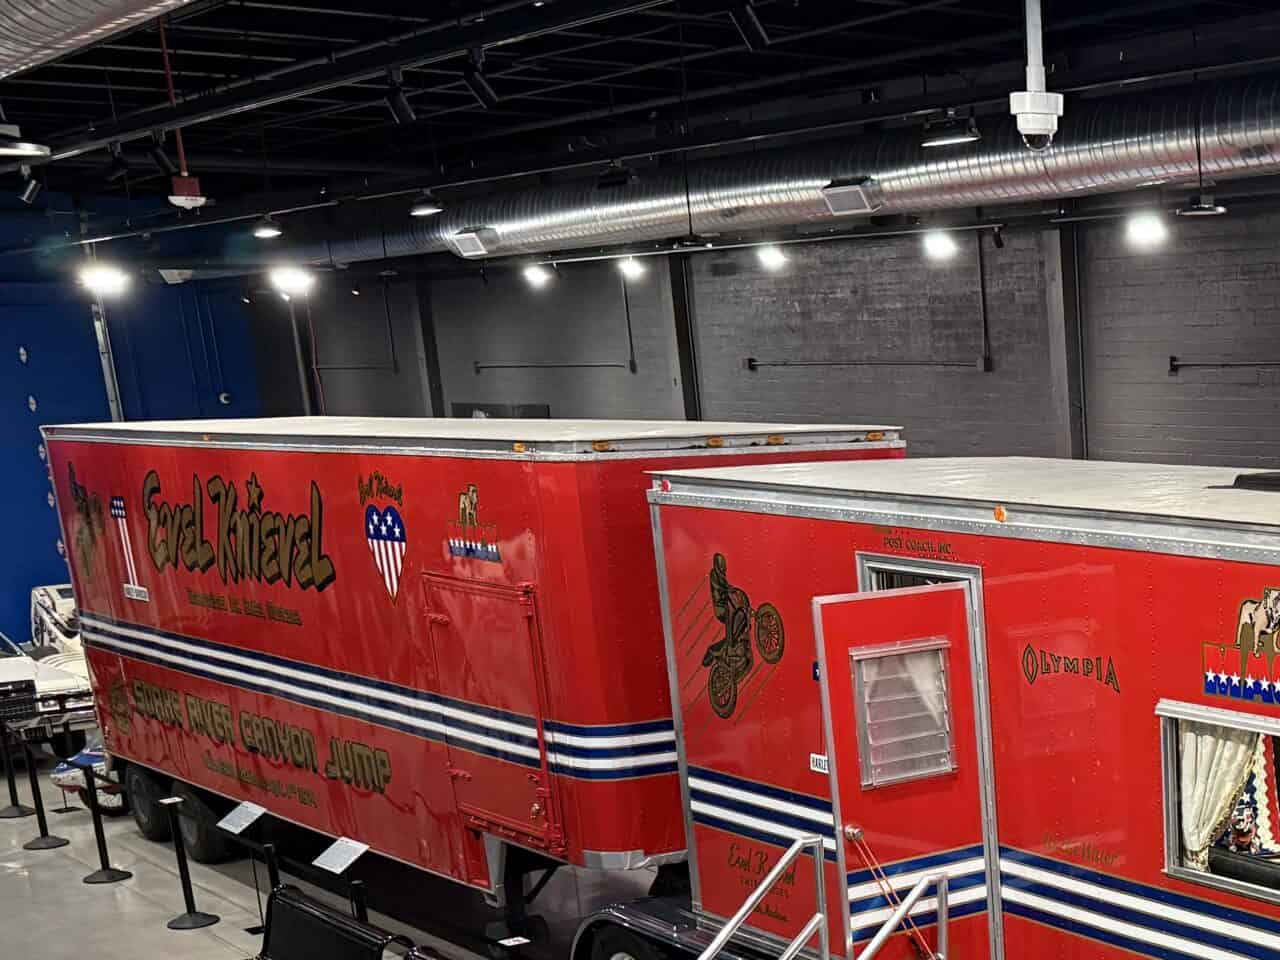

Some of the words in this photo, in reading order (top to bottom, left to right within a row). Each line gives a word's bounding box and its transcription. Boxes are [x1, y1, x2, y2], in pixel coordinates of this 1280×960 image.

[1022, 643, 1120, 693] OLYMPIA
[184, 693, 236, 747] RIVER
[239, 711, 319, 775] CANYON
[325, 737, 392, 794] JUMP
